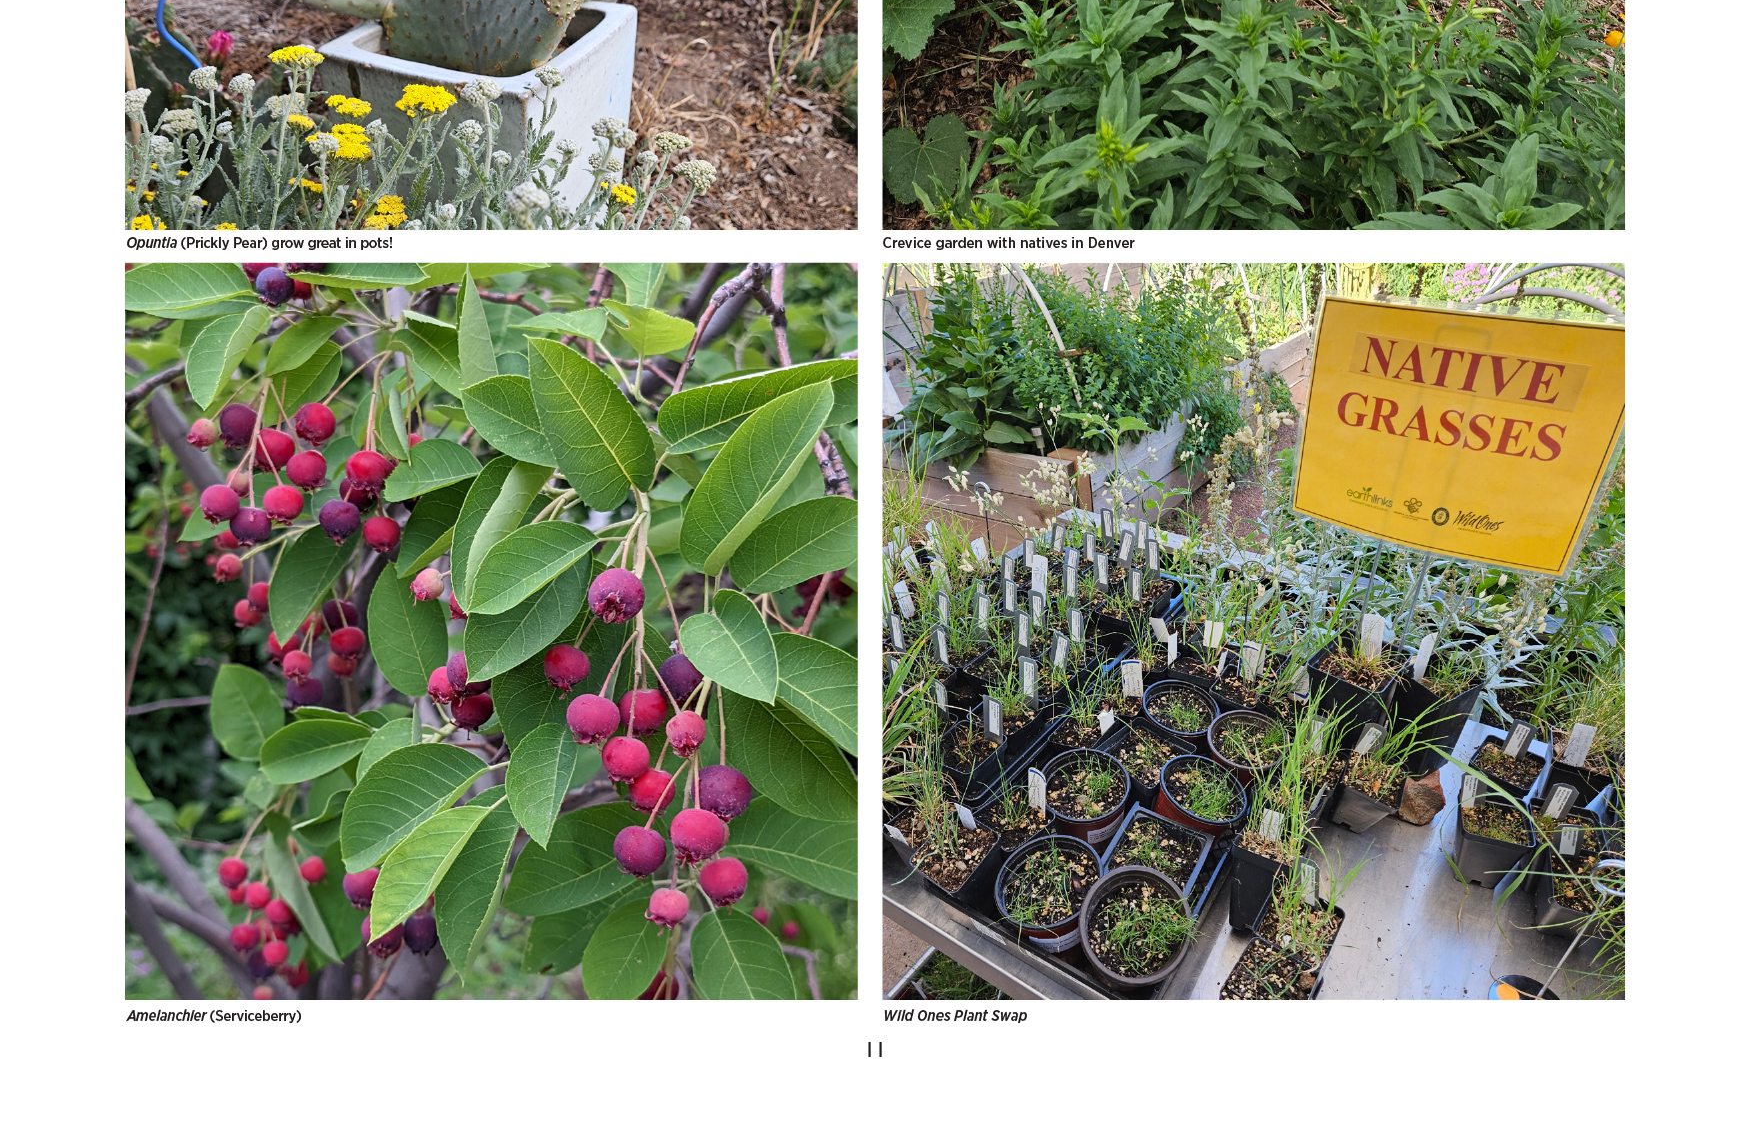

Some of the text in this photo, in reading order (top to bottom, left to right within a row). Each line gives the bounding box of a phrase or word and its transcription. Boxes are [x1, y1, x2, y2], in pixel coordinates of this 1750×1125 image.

[1360, 336, 1566, 404] NATIVE
[1337, 392, 1567, 462] GRASSES
[1346, 488, 1394, 508] earthlinks
